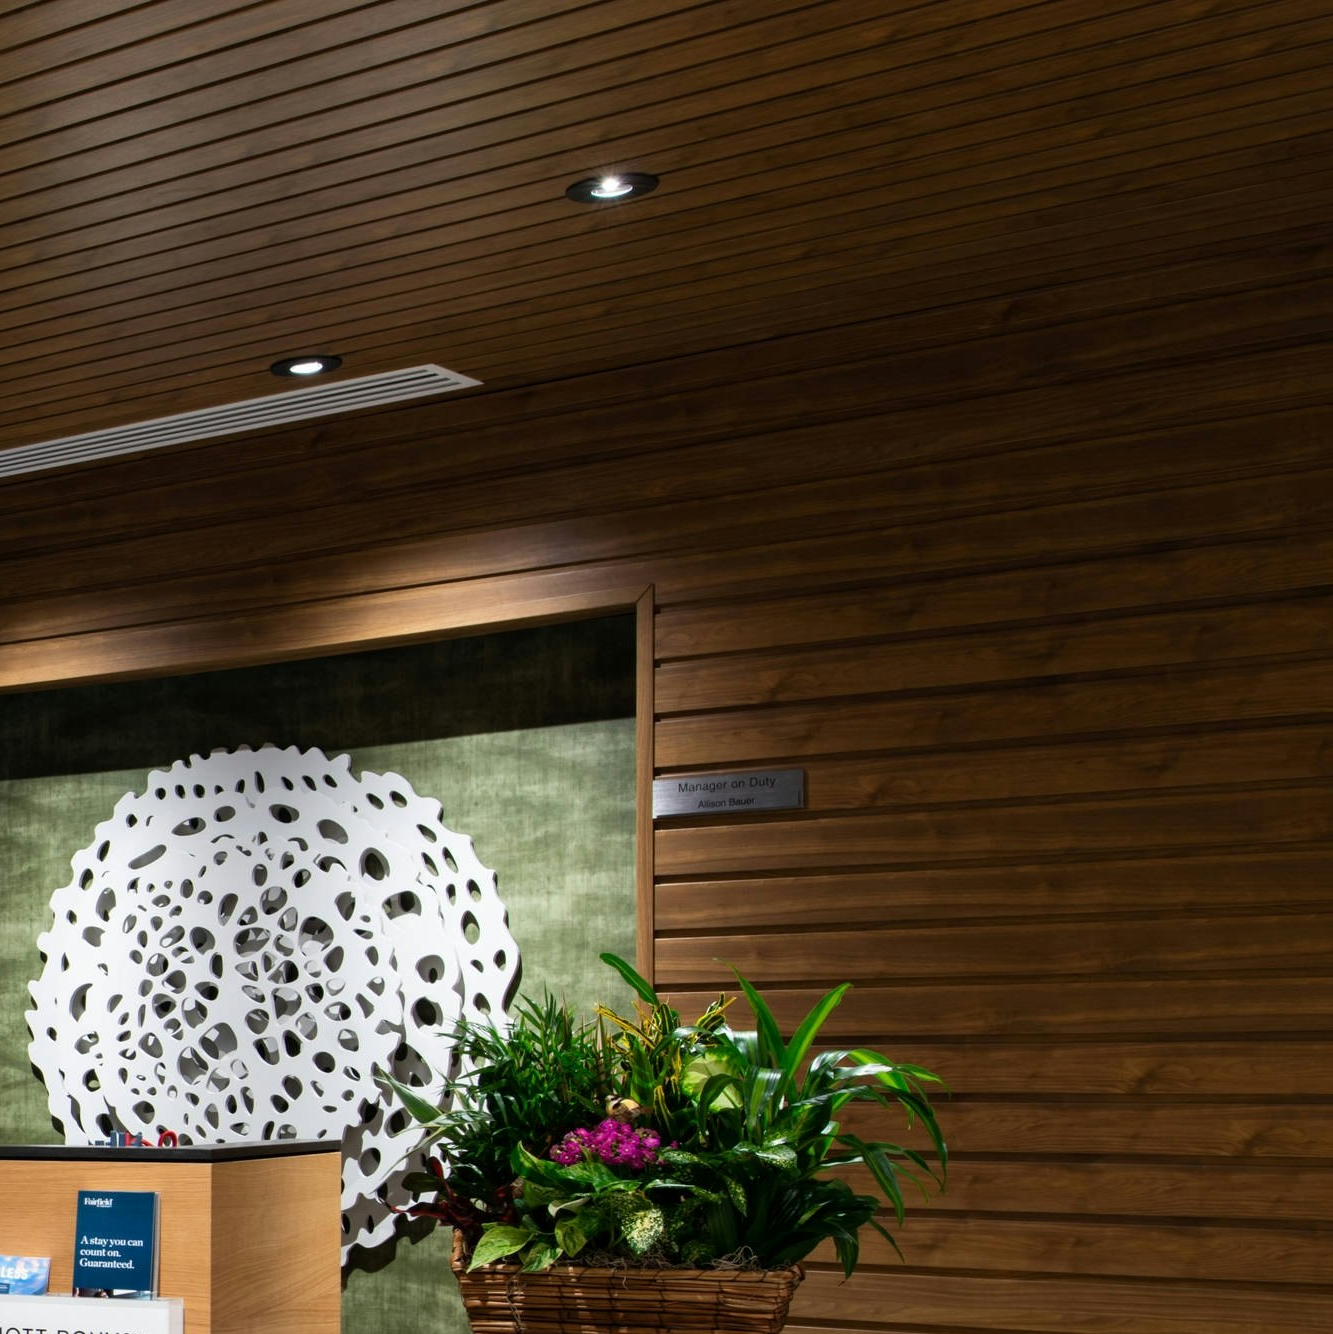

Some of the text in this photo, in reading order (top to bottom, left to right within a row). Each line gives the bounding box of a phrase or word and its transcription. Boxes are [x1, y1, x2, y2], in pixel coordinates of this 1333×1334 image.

[678, 777, 777, 793] Manager on Duty
[84, 1198, 113, 1206] Fairfield
[80, 1235, 89, 1245] A
[89, 1236, 109, 1247] stay
[109, 1239, 126, 1247] you
[80, 1249, 106, 1257] count
[79, 1258, 135, 1269] Guaranteed.
